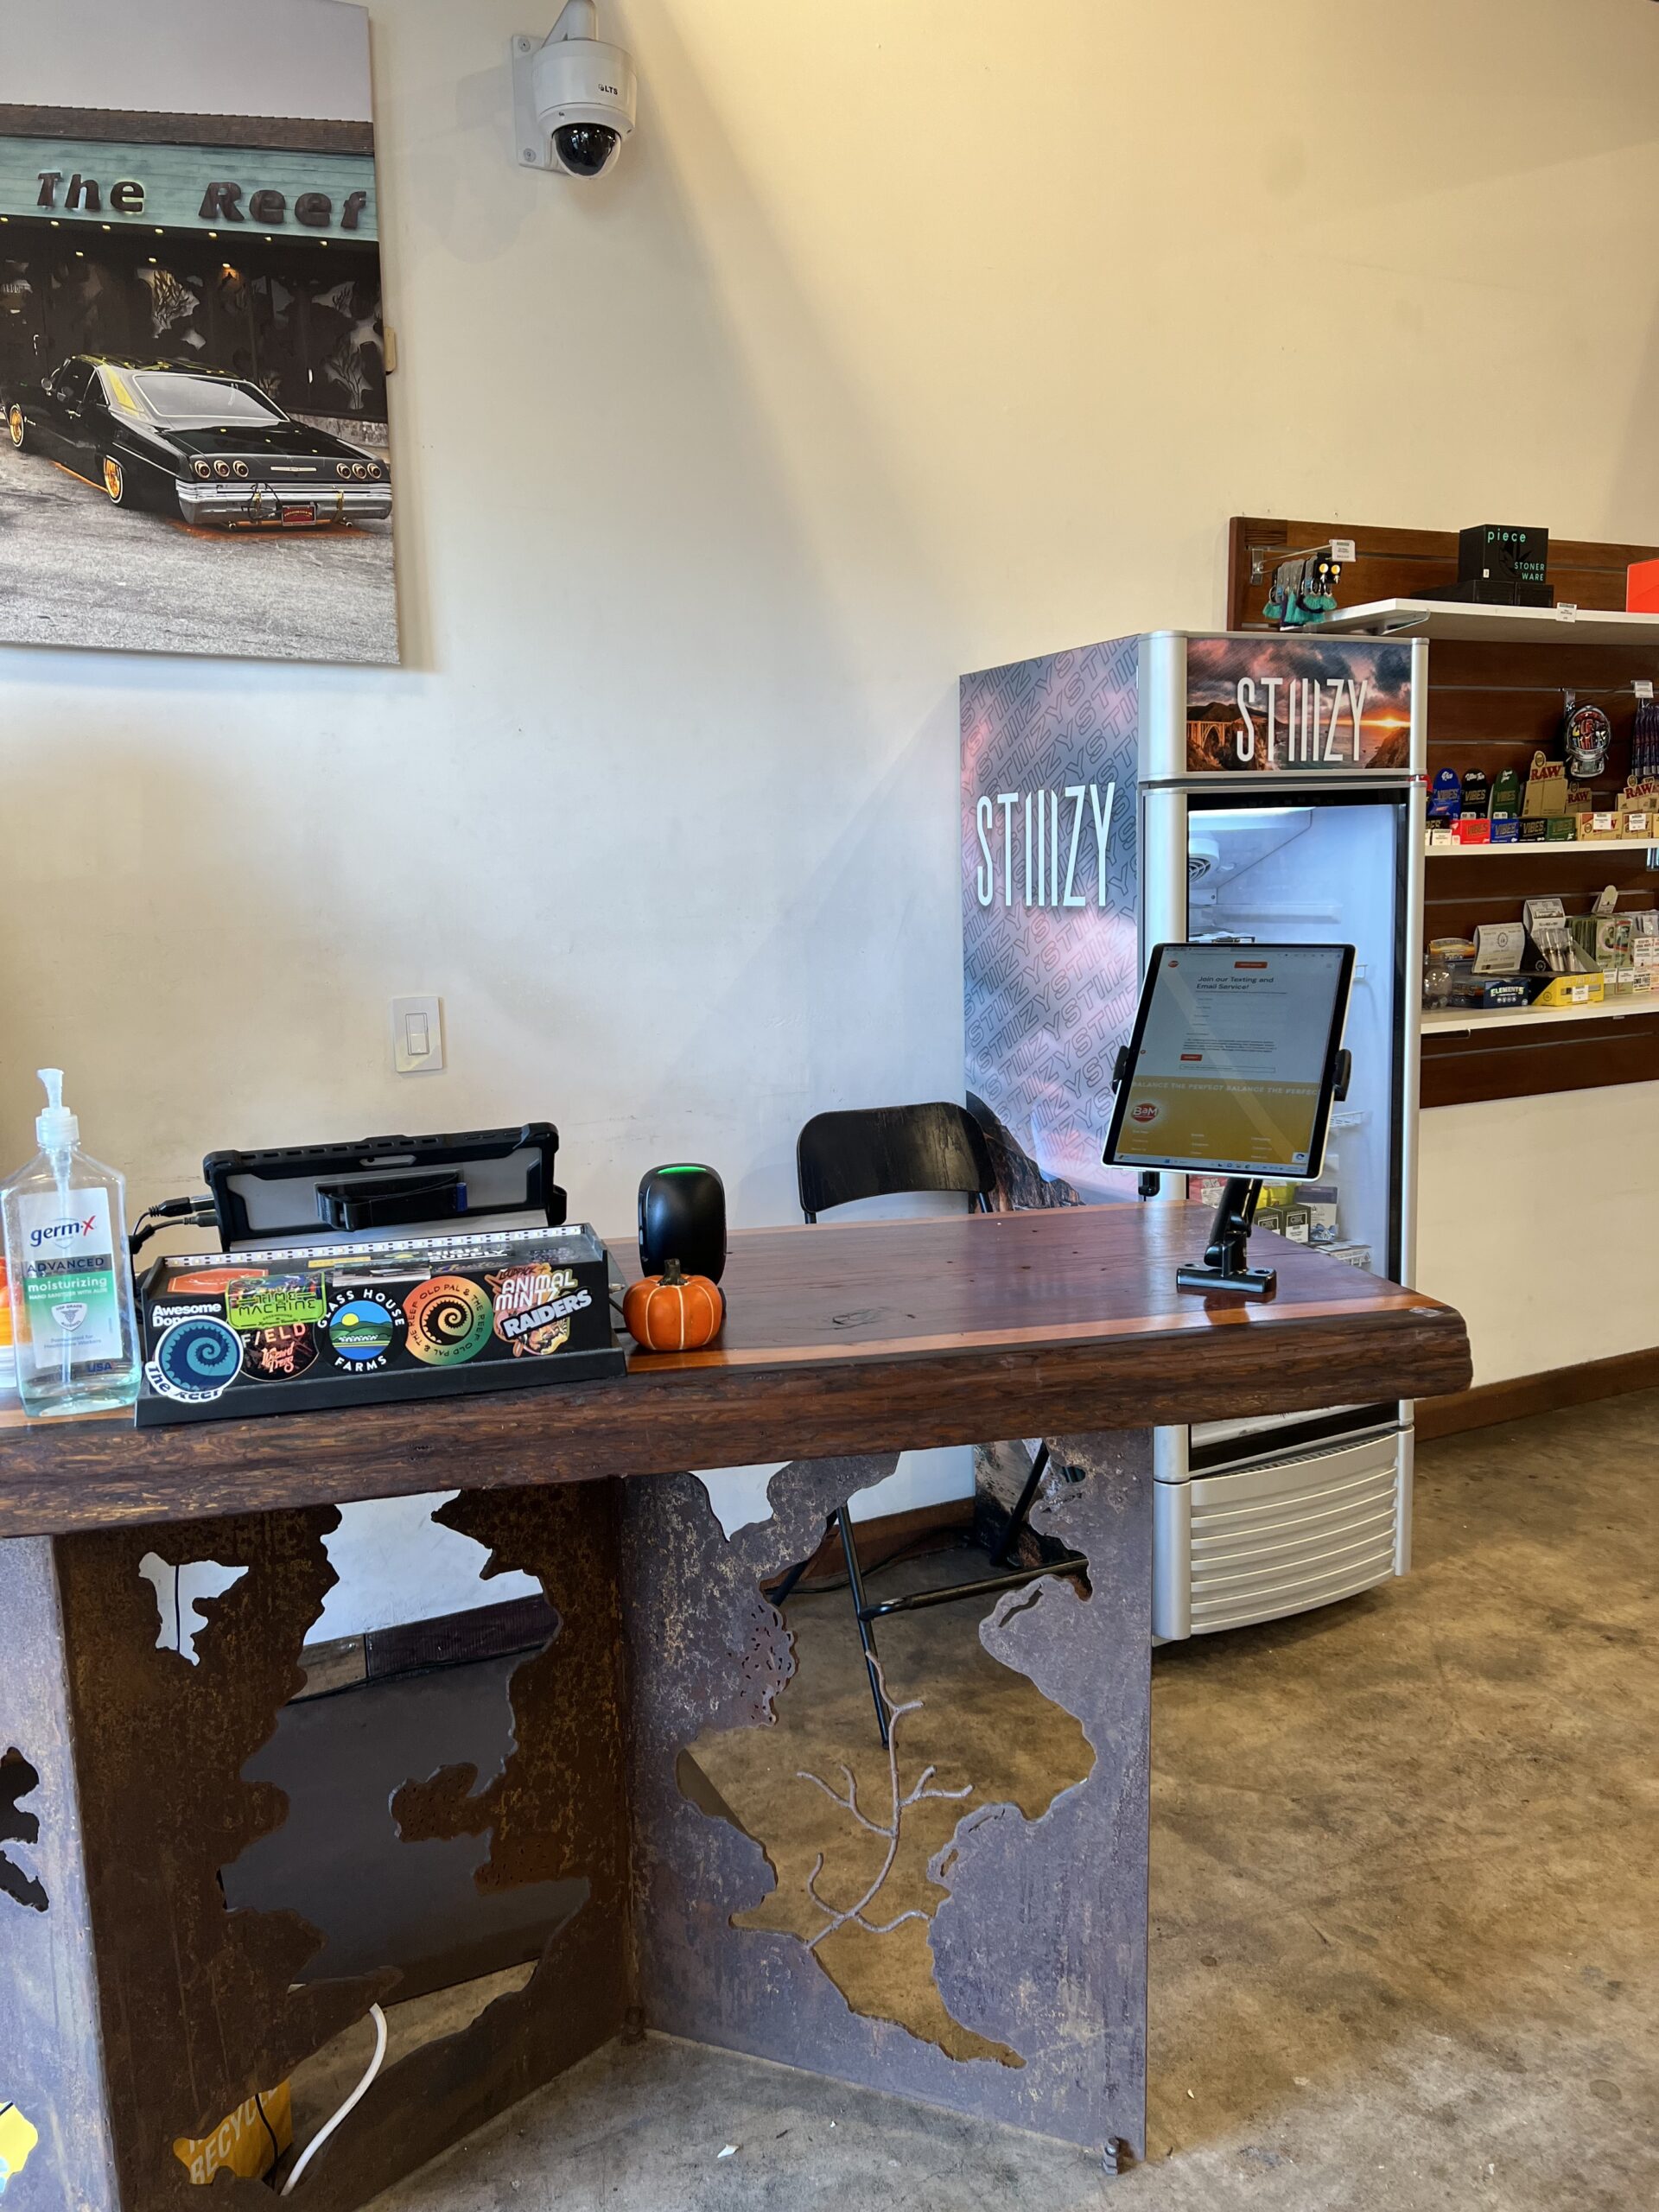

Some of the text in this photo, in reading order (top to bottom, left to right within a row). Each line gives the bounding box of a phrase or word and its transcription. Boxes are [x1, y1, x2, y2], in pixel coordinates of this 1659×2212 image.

[605, 86, 618, 95] LTS
[37, 172, 367, 229] The Reef
[1487, 528, 1527, 543] piece
[1514, 562, 1545, 571] STONER
[1522, 572, 1544, 582] WARE
[1236, 677, 1368, 762] STIIIZY
[1531, 765, 1562, 780] RAW
[1437, 789, 1459, 800] VIBES
[1465, 790, 1486, 802] VIBES
[1568, 791, 1589, 804] RAW
[1625, 783, 1654, 799] RAW
[1523, 822, 1545, 835] VIBES
[976, 781, 1116, 906] STIIIZY
[1491, 986, 1524, 997] ELEMENTS
[1133, 1107, 1158, 1116] BaM
[28, 1258, 104, 1273] ADVANCED
[29, 1277, 107, 1292] moisturizing
[502, 1271, 575, 1294] ANIMAL
[420, 1286, 441, 1300] OLD
[495, 1287, 560, 1311] MINTZ
[153, 1303, 221, 1316] Awesome
[238, 1300, 315, 1316] MACHINE
[317, 1288, 405, 1328] GLASS HOUSE
[471, 1295, 483, 1311] THE
[408, 1302, 418, 1326] REEF
[503, 1289, 592, 1338] RAIDERS
[153, 1316, 189, 1327] Dop
[474, 1314, 485, 1341] REEF
[241, 1323, 306, 1348] FIELD
[410, 1330, 423, 1345] THE
[454, 1343, 473, 1355] OLD
[88, 1362, 112, 1372] USA
[334, 1355, 387, 1371] FARMS
[148, 1366, 171, 1392] The
